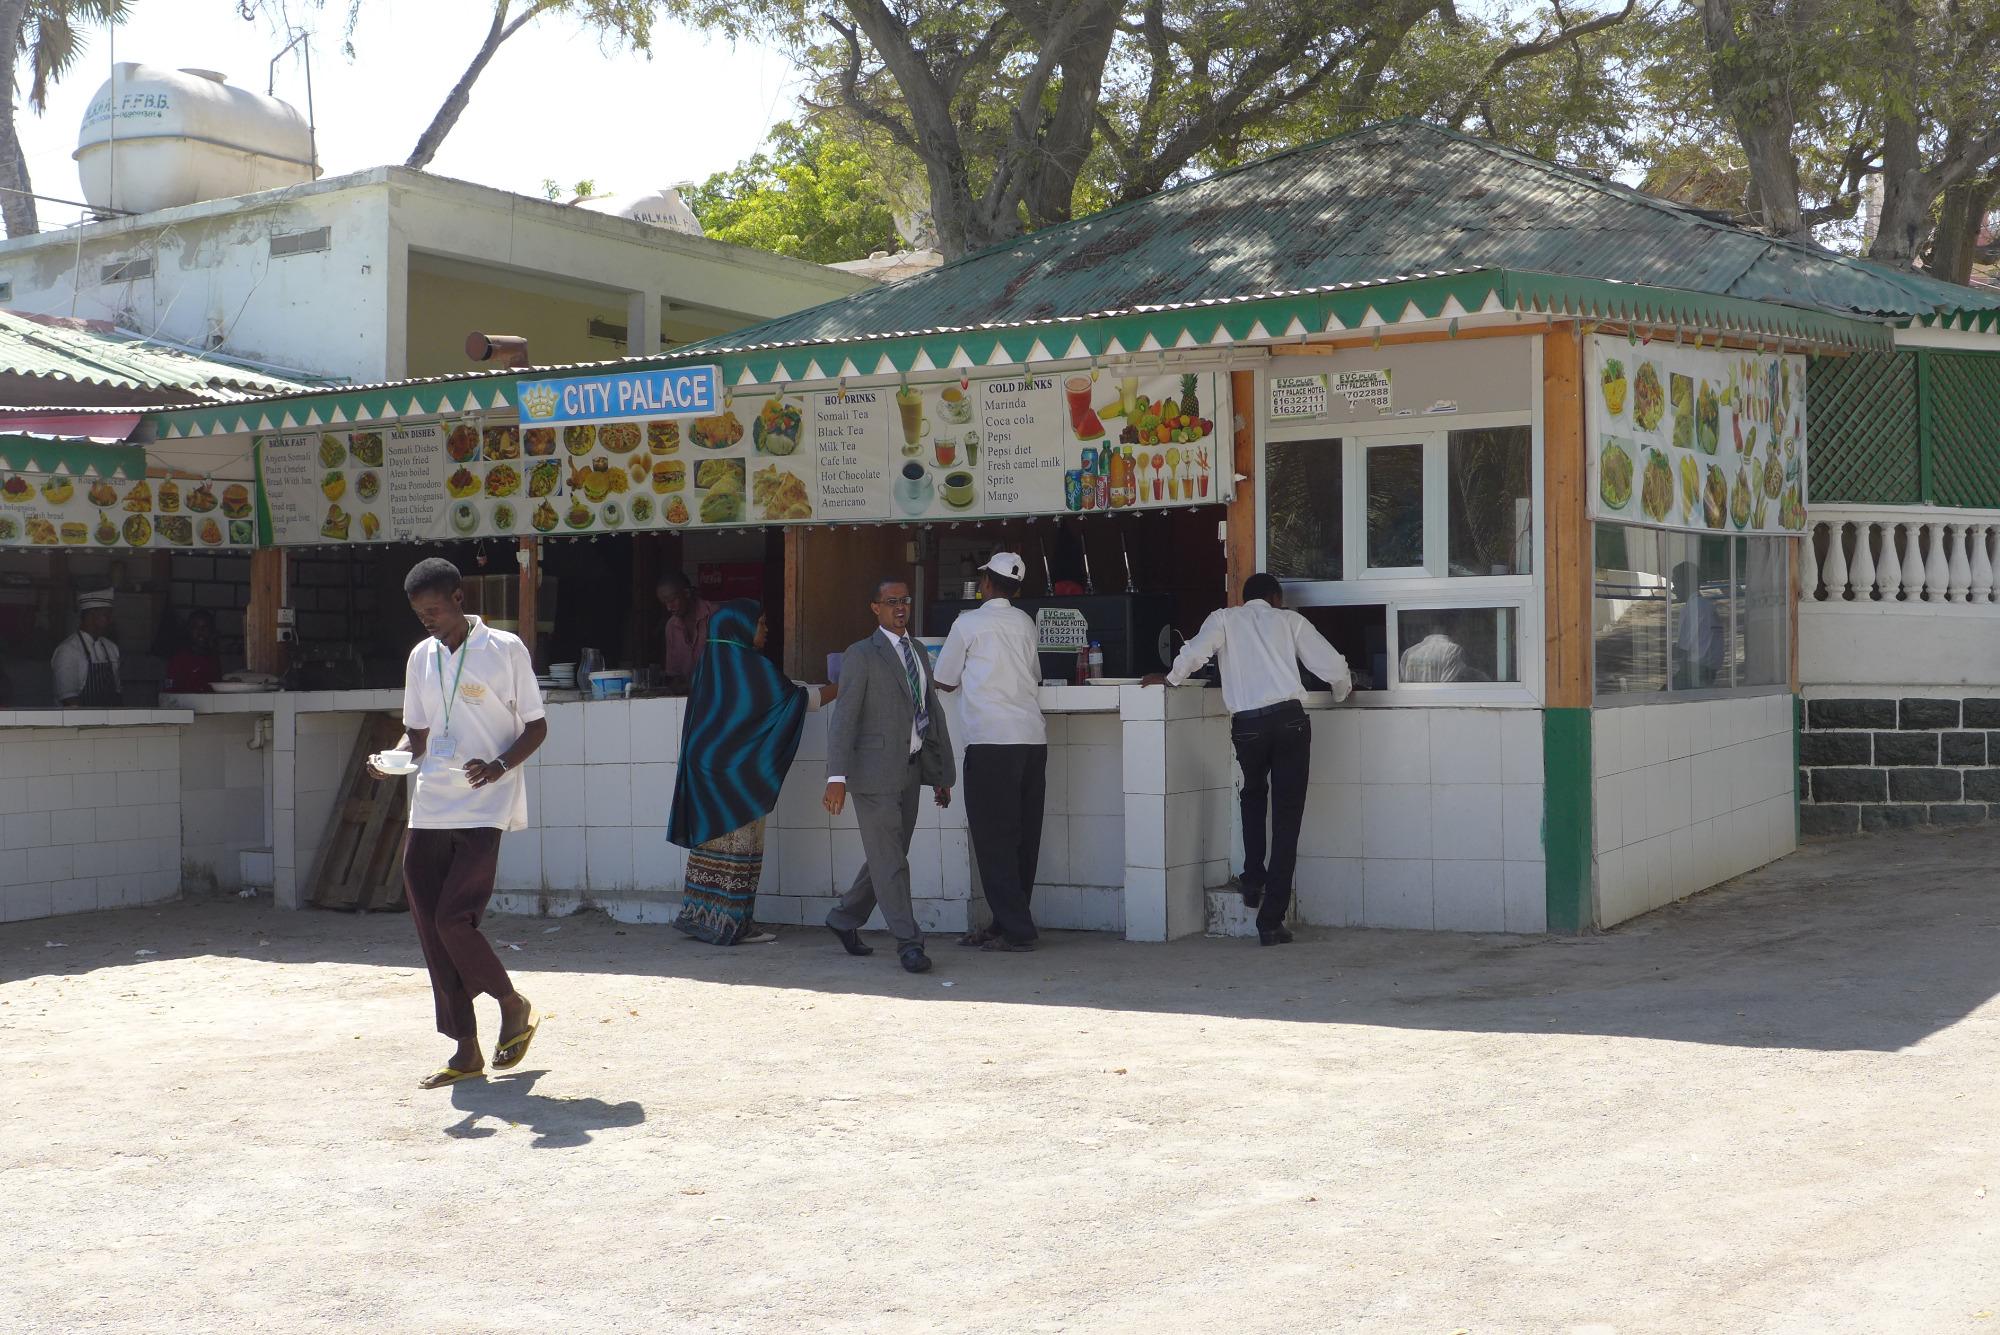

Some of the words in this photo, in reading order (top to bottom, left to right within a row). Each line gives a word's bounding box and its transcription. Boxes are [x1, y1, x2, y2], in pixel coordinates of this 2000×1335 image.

[1277, 378, 1295, 387] EVC
[1339, 373, 1357, 382] EVC
[1358, 372, 1377, 380] PLUS
[989, 382, 1015, 393] COLD
[1017, 379, 1053, 391] DRINKS
[1335, 383, 1348, 391] CITY
[1349, 381, 1369, 389] PALACE
[1370, 379, 1388, 387] HOTEL
[564, 382, 612, 416] CITY
[617, 375, 708, 411] PALACE
[1272, 389, 1286, 397] CITY
[1286, 388, 1307, 396] PALACE
[1307, 387, 1325, 395] HOTEL
[825, 396, 842, 406] HOT
[845, 393, 877, 404] DRINKS
[985, 398, 1026, 411] Marinda
[1273, 395, 1325, 406] 616322111
[1273, 404, 1325, 415] 616322111
[817, 410, 849, 421] Somali
[853, 410, 868, 419] Tea
[985, 416, 1010, 427] Coca
[1013, 414, 1034, 425] cola
[391, 430, 410, 440] MAIN
[411, 429, 436, 439] DISHES
[818, 427, 844, 437] Black
[847, 426, 864, 435] Tea
[291, 438, 307, 447] FAST
[987, 432, 1011, 444] Pepsi
[388, 445, 413, 455] Somali
[415, 444, 439, 453] Dishes
[819, 441, 838, 451] Milk
[841, 441, 856, 450] Tea
[987, 446, 1011, 458] Pepsi
[1014, 445, 1031, 455] diet
[412, 455, 430, 465] fried
[820, 456, 840, 466] Cafe
[842, 455, 857, 465] late
[988, 460, 1011, 471] Fresh
[1013, 458, 1038, 469] camel
[1040, 456, 1060, 468] milk
[409, 467, 430, 477] boiled
[821, 471, 836, 481] Hot
[838, 470, 881, 480] Chocolate
[390, 482, 407, 491] Pasta
[408, 479, 442, 490] Pomodoro
[987, 475, 1014, 487] Sprite
[822, 484, 864, 495] Macchiato
[390, 494, 407, 503] Pasta
[987, 490, 1019, 503] Mango
[821, 498, 866, 508] Americano
[409, 504, 434, 514] Chicken
